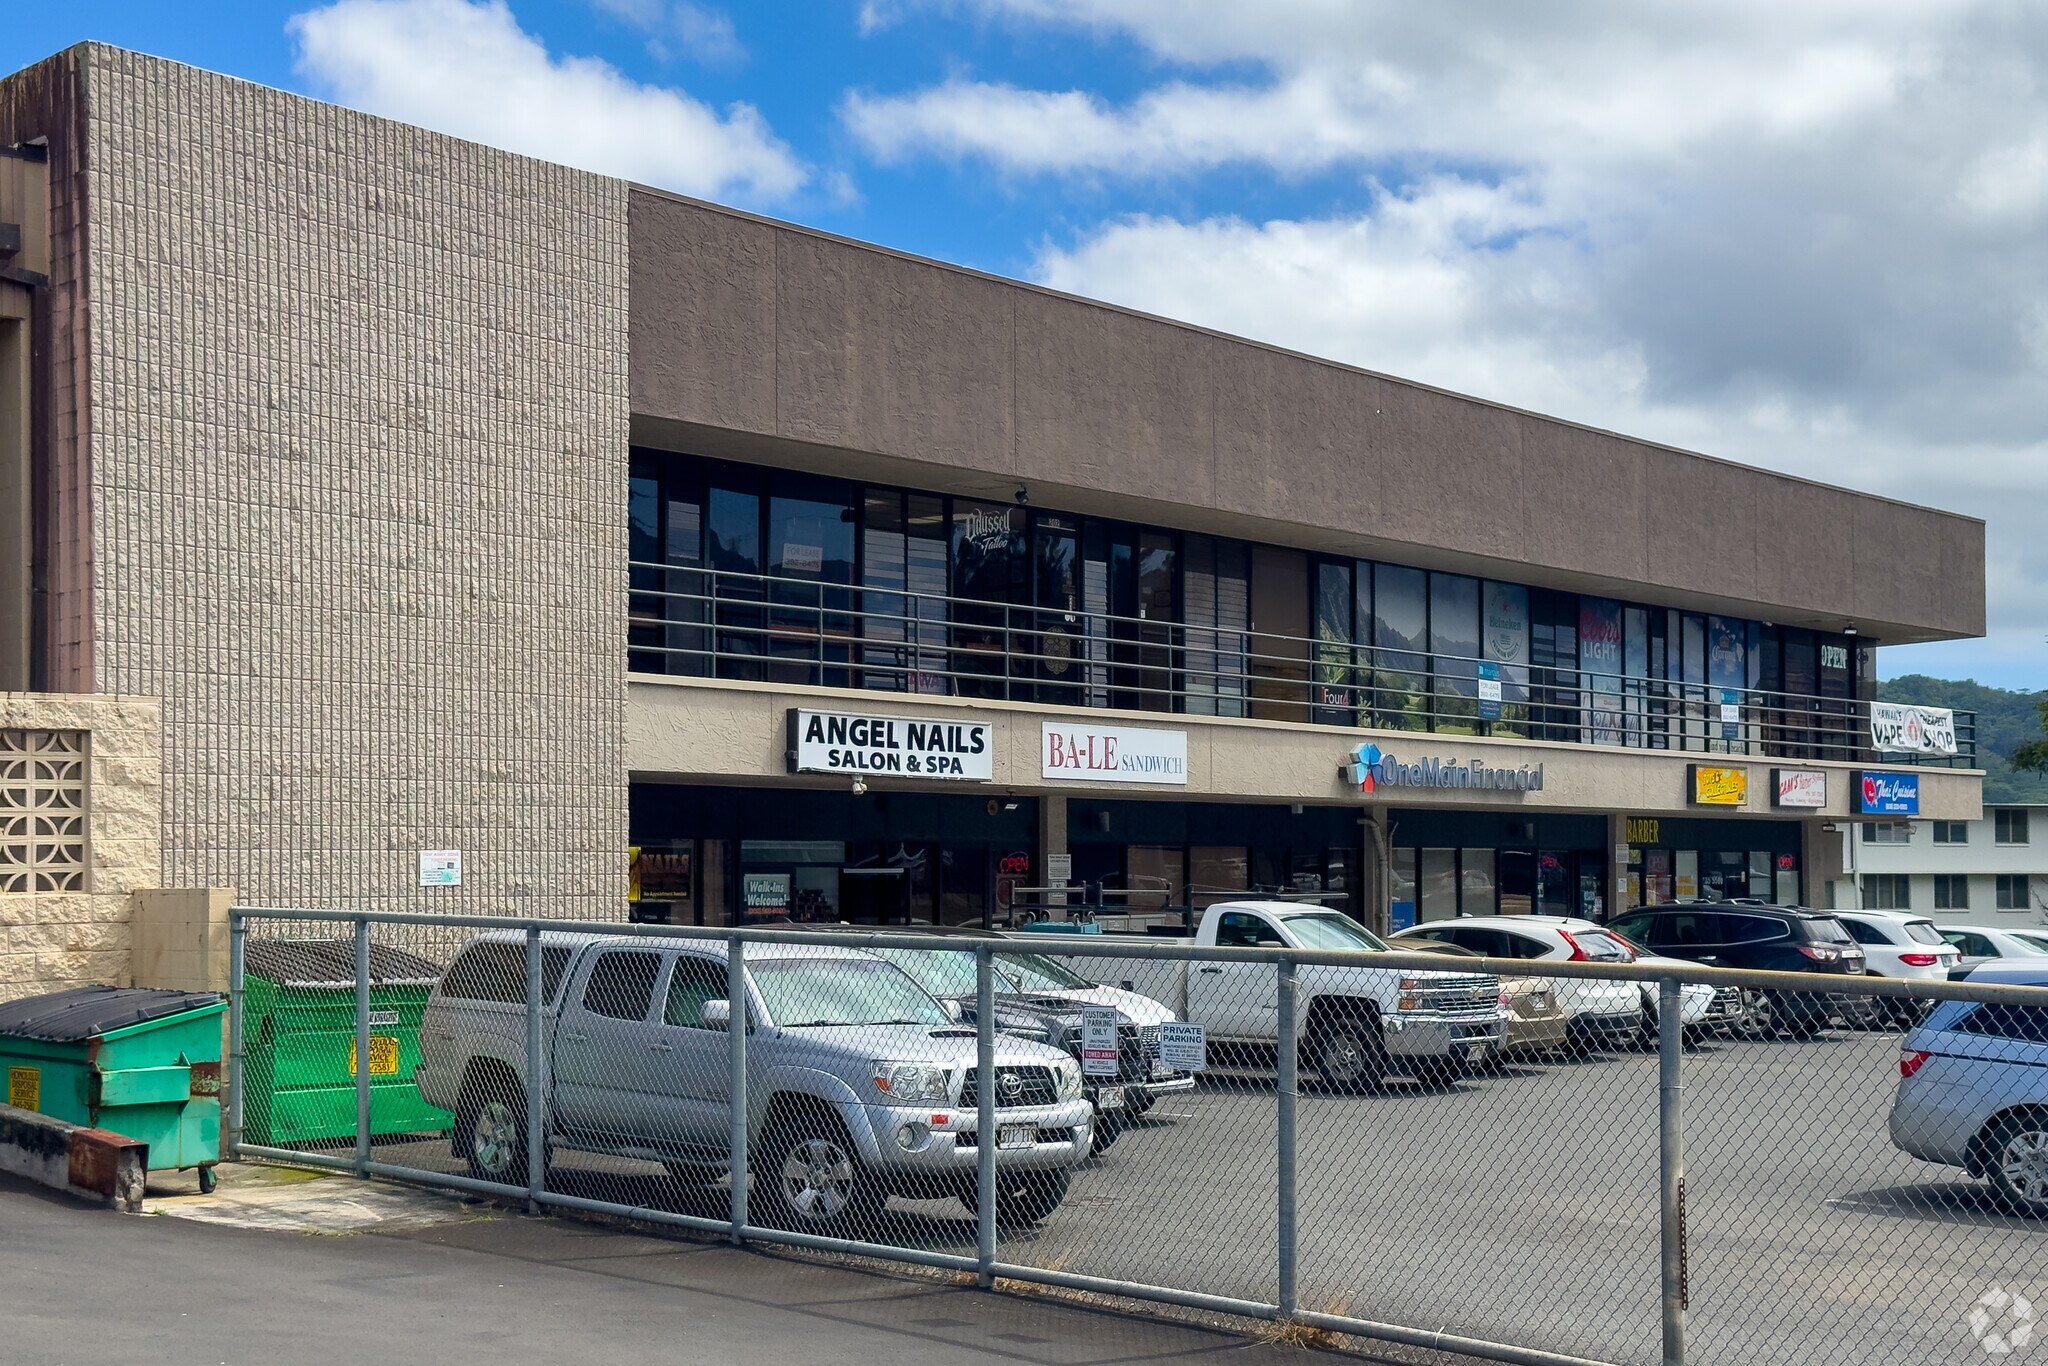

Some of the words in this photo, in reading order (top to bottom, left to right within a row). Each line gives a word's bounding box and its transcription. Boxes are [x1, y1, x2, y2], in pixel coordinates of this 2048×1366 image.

[982, 535, 1008, 555] Tattoo
[1489, 615, 1522, 630] Heineken
[1580, 607, 1620, 643] Coors
[1583, 640, 1617, 661] LIGHT
[1821, 644, 1848, 669] OPEN
[805, 715, 899, 749] ANGEL
[907, 723, 985, 754] NAILS
[1873, 723, 1905, 745] VAPE
[1923, 729, 1953, 750] SHOP
[828, 749, 901, 771] SALON
[906, 754, 922, 772] &
[926, 756, 963, 775] SPA
[1048, 732, 1119, 770] BA-LE
[1122, 754, 1182, 774] SANDWICH
[1380, 753, 1544, 791] OneMainFinancial
[1876, 779, 1892, 798] Thai
[1891, 780, 1916, 802] Cuisine
[1626, 819, 1659, 843] BARBER
[641, 853, 690, 874] NAILS
[999, 856, 1029, 872] OPEN
[747, 894, 787, 906] Welcome!
[1085, 1010, 1115, 1019] CUSTOMER
[1087, 1020, 1112, 1028] PARKING
[1092, 1028, 1108, 1036] ONLY
[1163, 1026, 1202, 1035] PRIVATE
[1163, 1035, 1202, 1044] PARKING
[1085, 1051, 1101, 1059] TOWED
[1101, 1051, 1116, 1059] AWAY
[11, 1071, 38, 1081] HONOLULU
[12, 1080, 37, 1090] DISPOSAL
[14, 1089, 35, 1099] SERVICE
